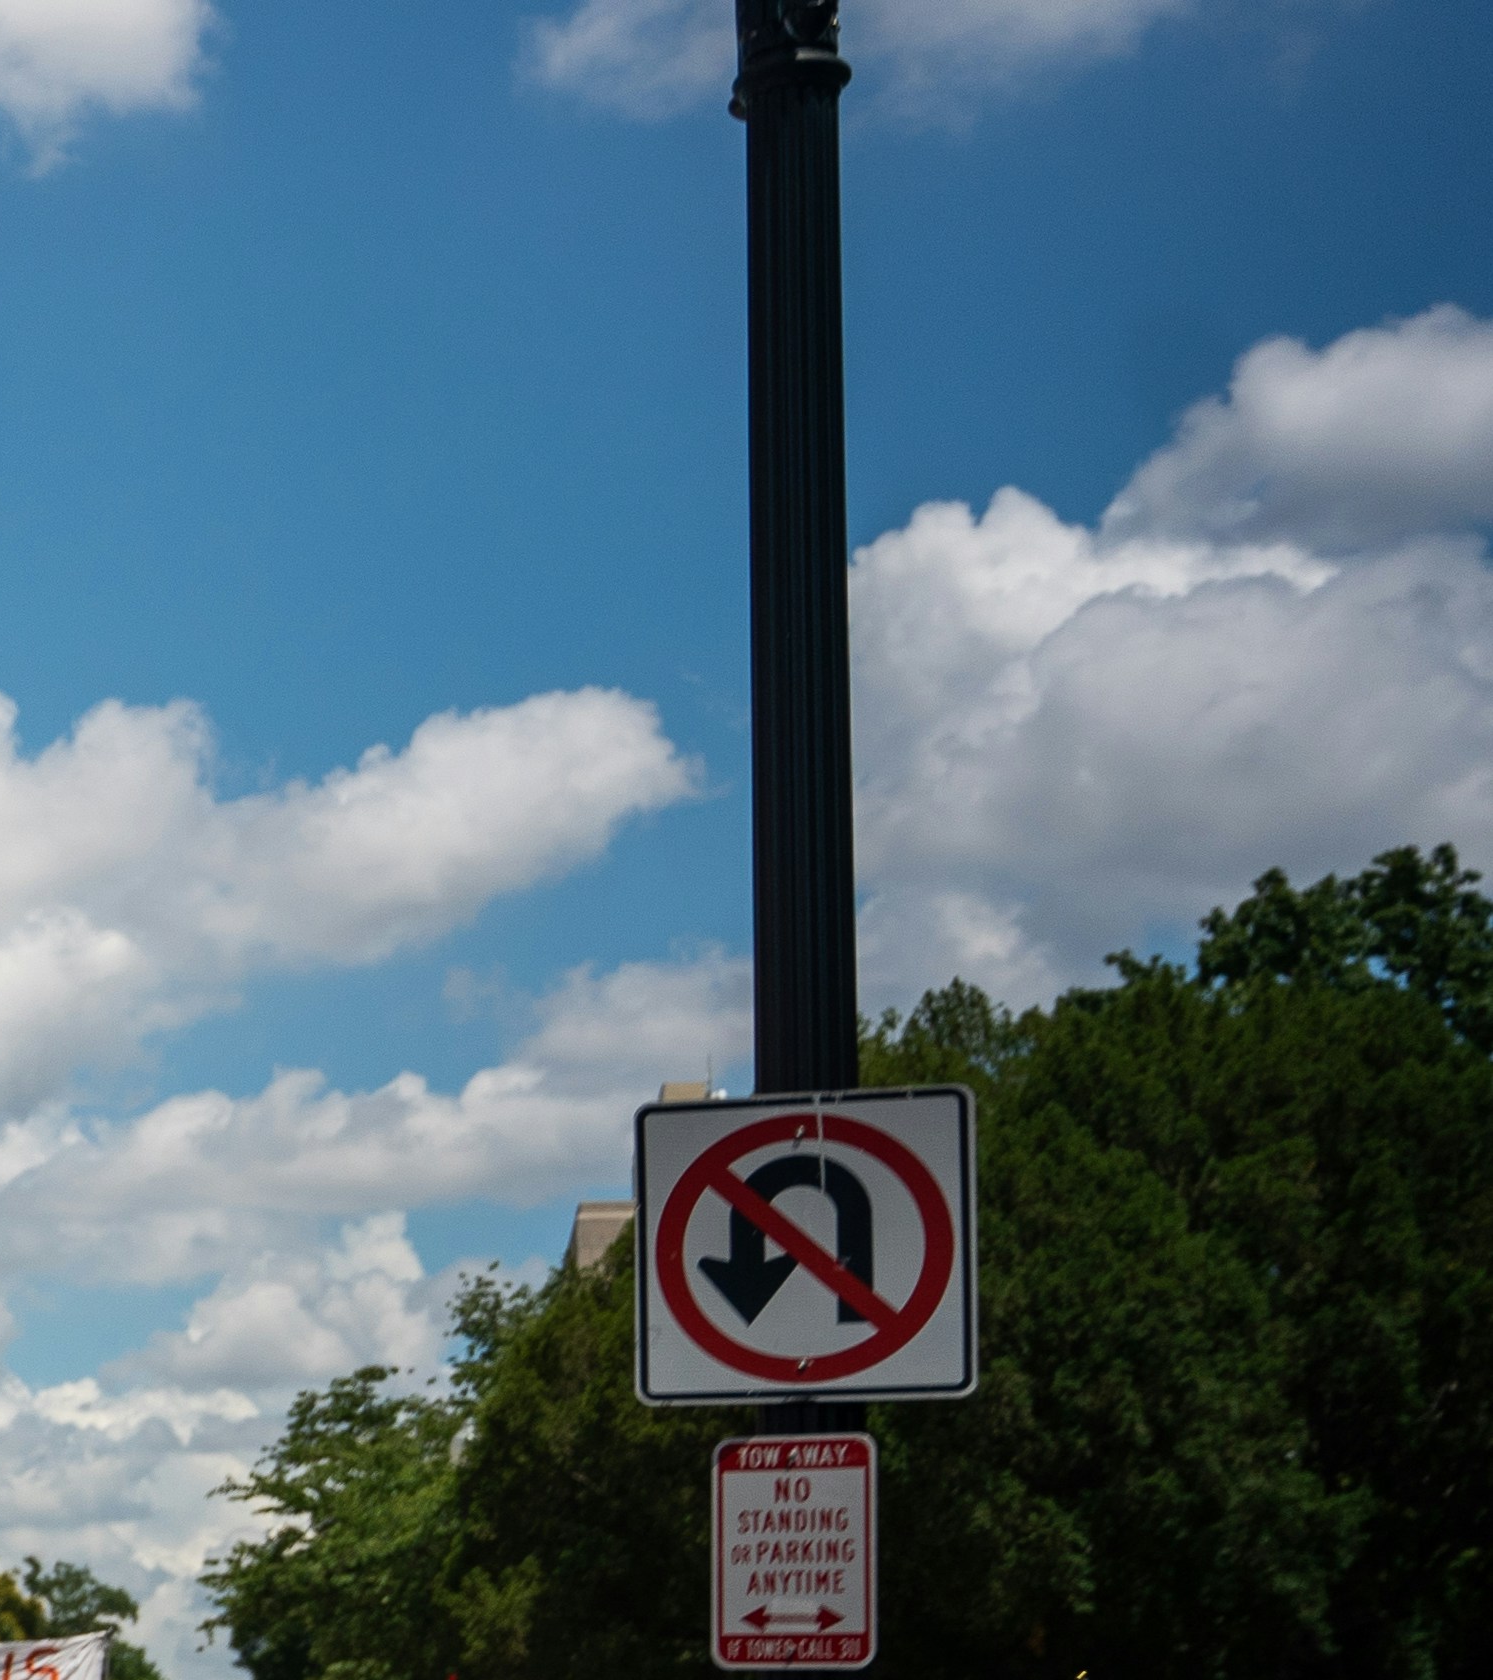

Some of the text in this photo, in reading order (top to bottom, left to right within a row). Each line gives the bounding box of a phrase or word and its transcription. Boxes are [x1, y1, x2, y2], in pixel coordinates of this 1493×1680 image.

[738, 1443, 849, 1469] TOW AWAY
[774, 1477, 811, 1504] NO
[737, 1507, 849, 1535] STANDING
[731, 1538, 856, 1566] OR PARKING
[746, 1569, 846, 1596] ANYTIME
[726, 1637, 861, 1660] IF TOWED CALL 311
